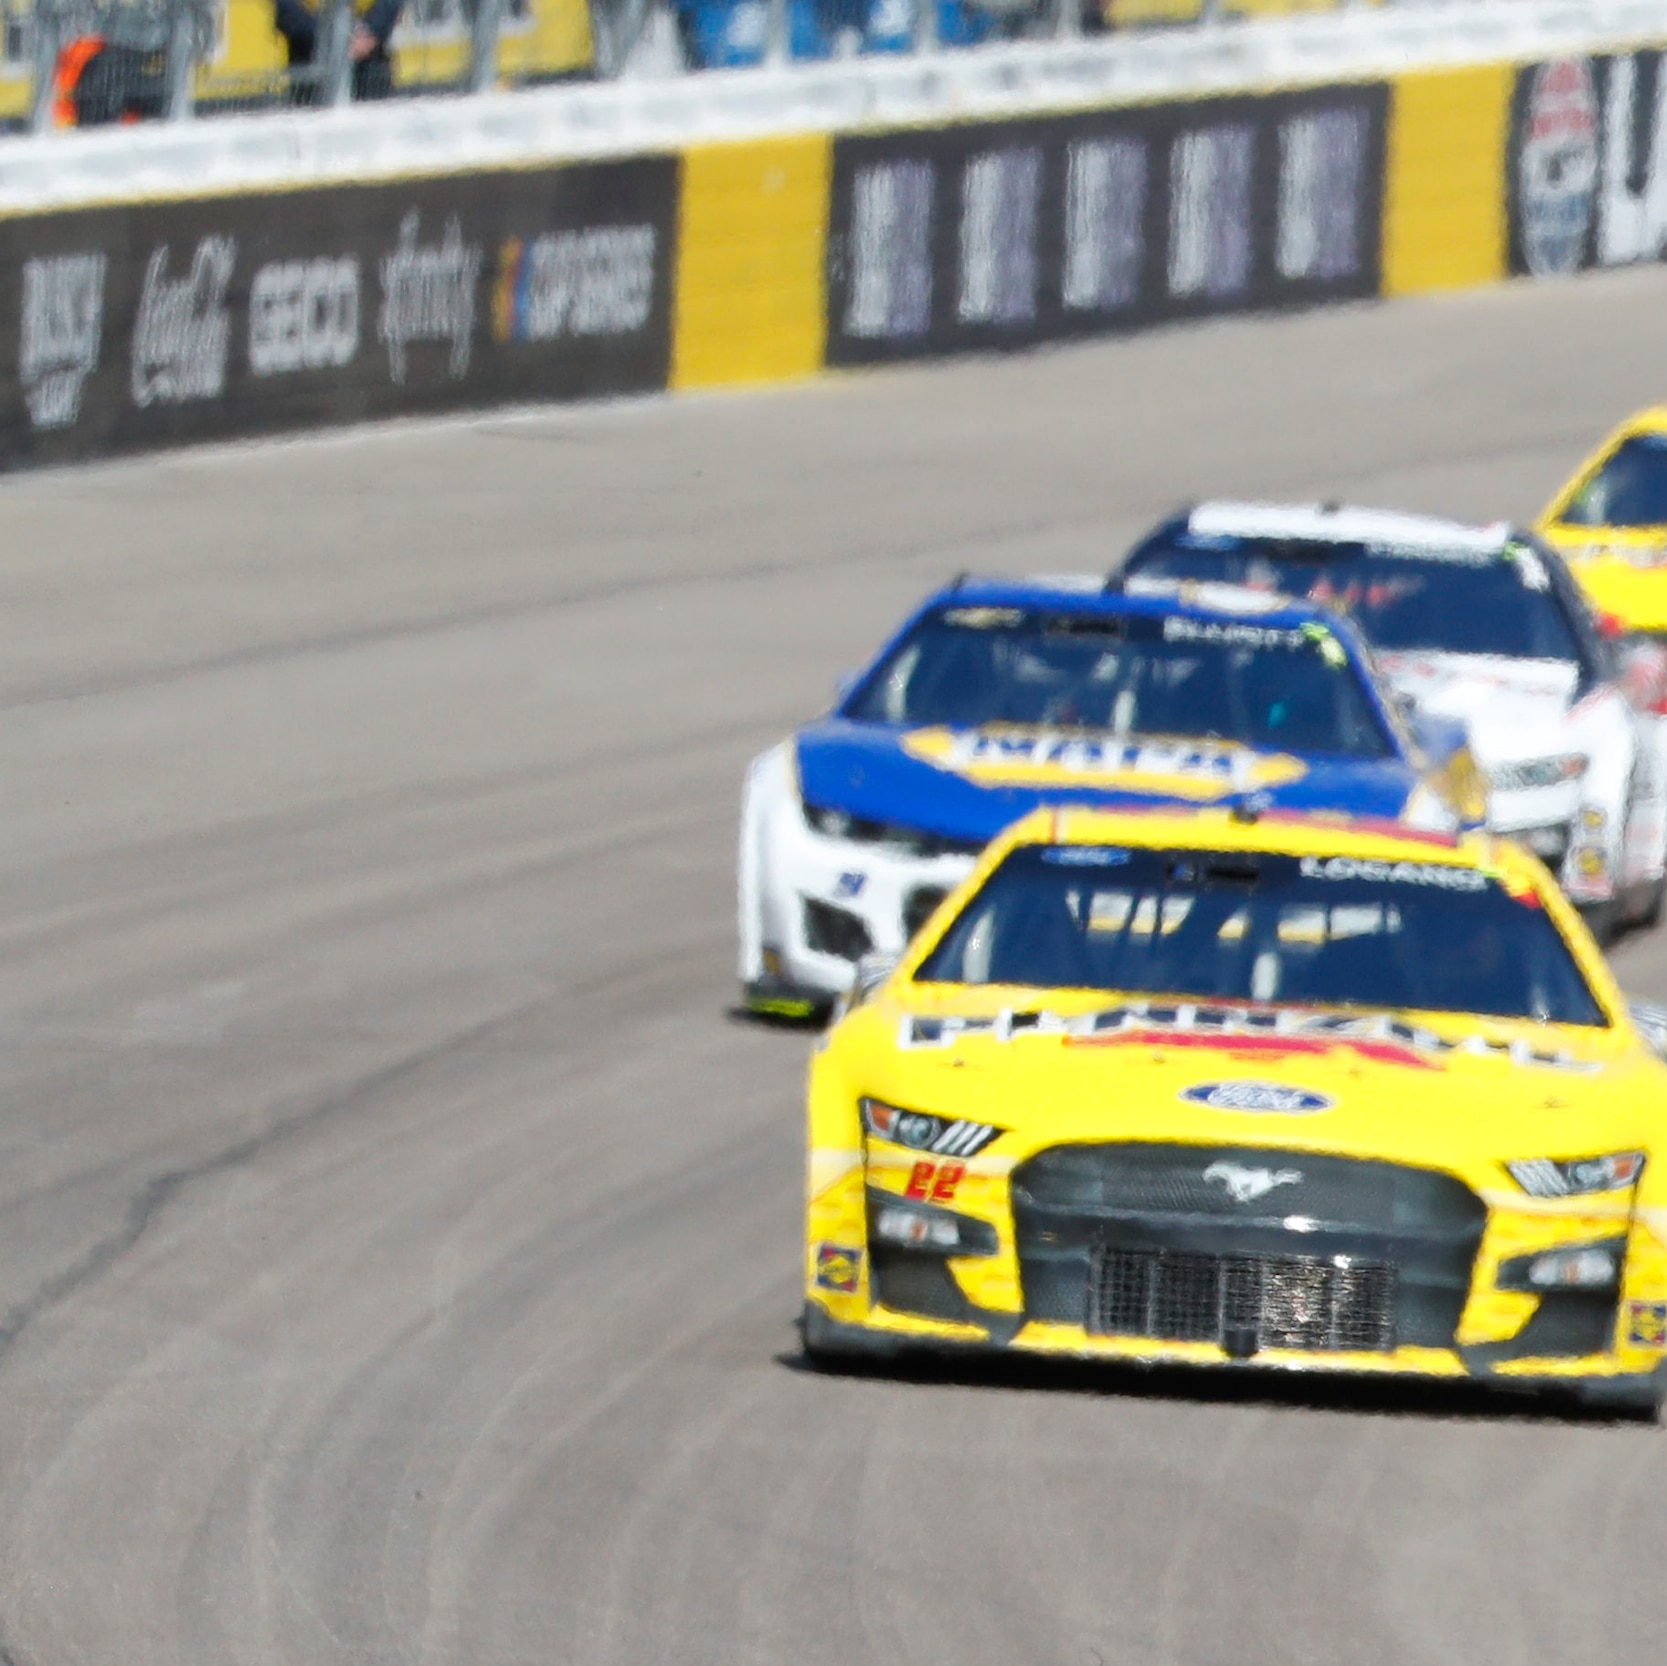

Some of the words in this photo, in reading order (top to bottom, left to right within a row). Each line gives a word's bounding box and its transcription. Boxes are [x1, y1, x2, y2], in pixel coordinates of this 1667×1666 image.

[249, 254, 360, 376] GEICO
[1299, 855, 1489, 892] LOGANO
[905, 1161, 966, 1200] 22
